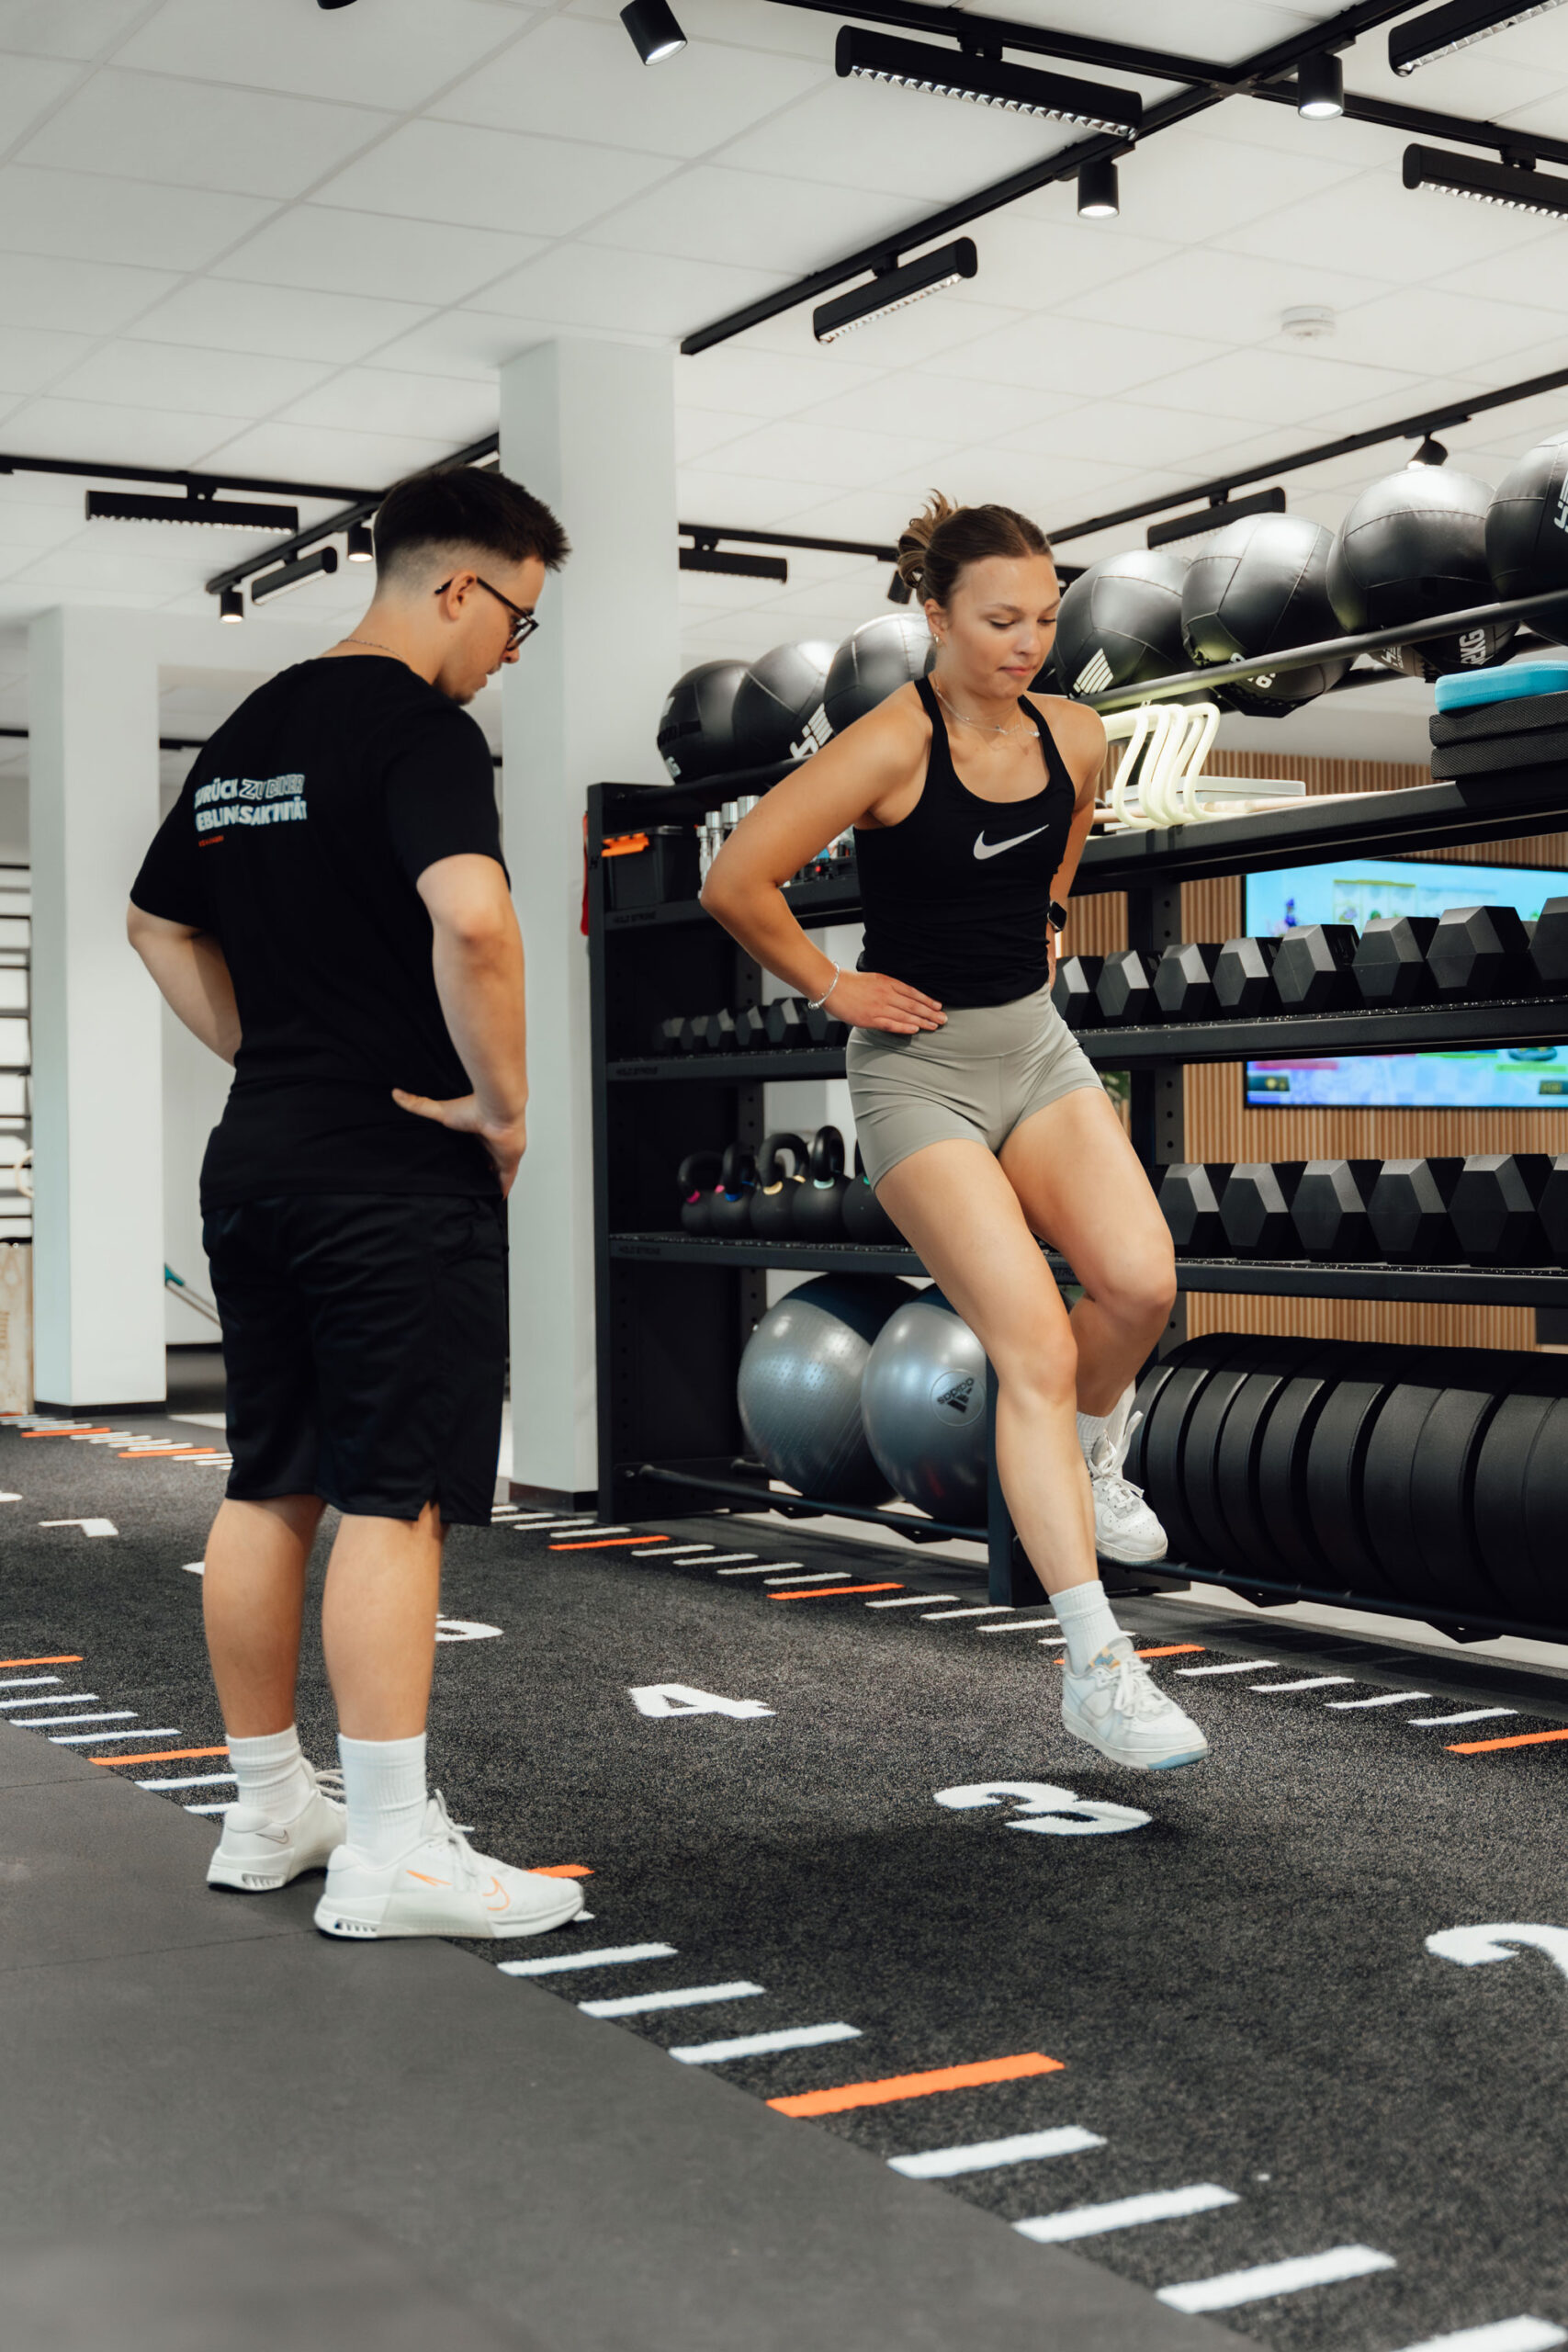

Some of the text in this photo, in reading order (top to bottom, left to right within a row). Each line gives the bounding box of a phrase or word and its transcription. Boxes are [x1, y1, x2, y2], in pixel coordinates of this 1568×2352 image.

[937, 1377, 975, 1405] adidas
[628, 1683, 779, 1720] 4
[932, 1781, 1153, 1837] 3
